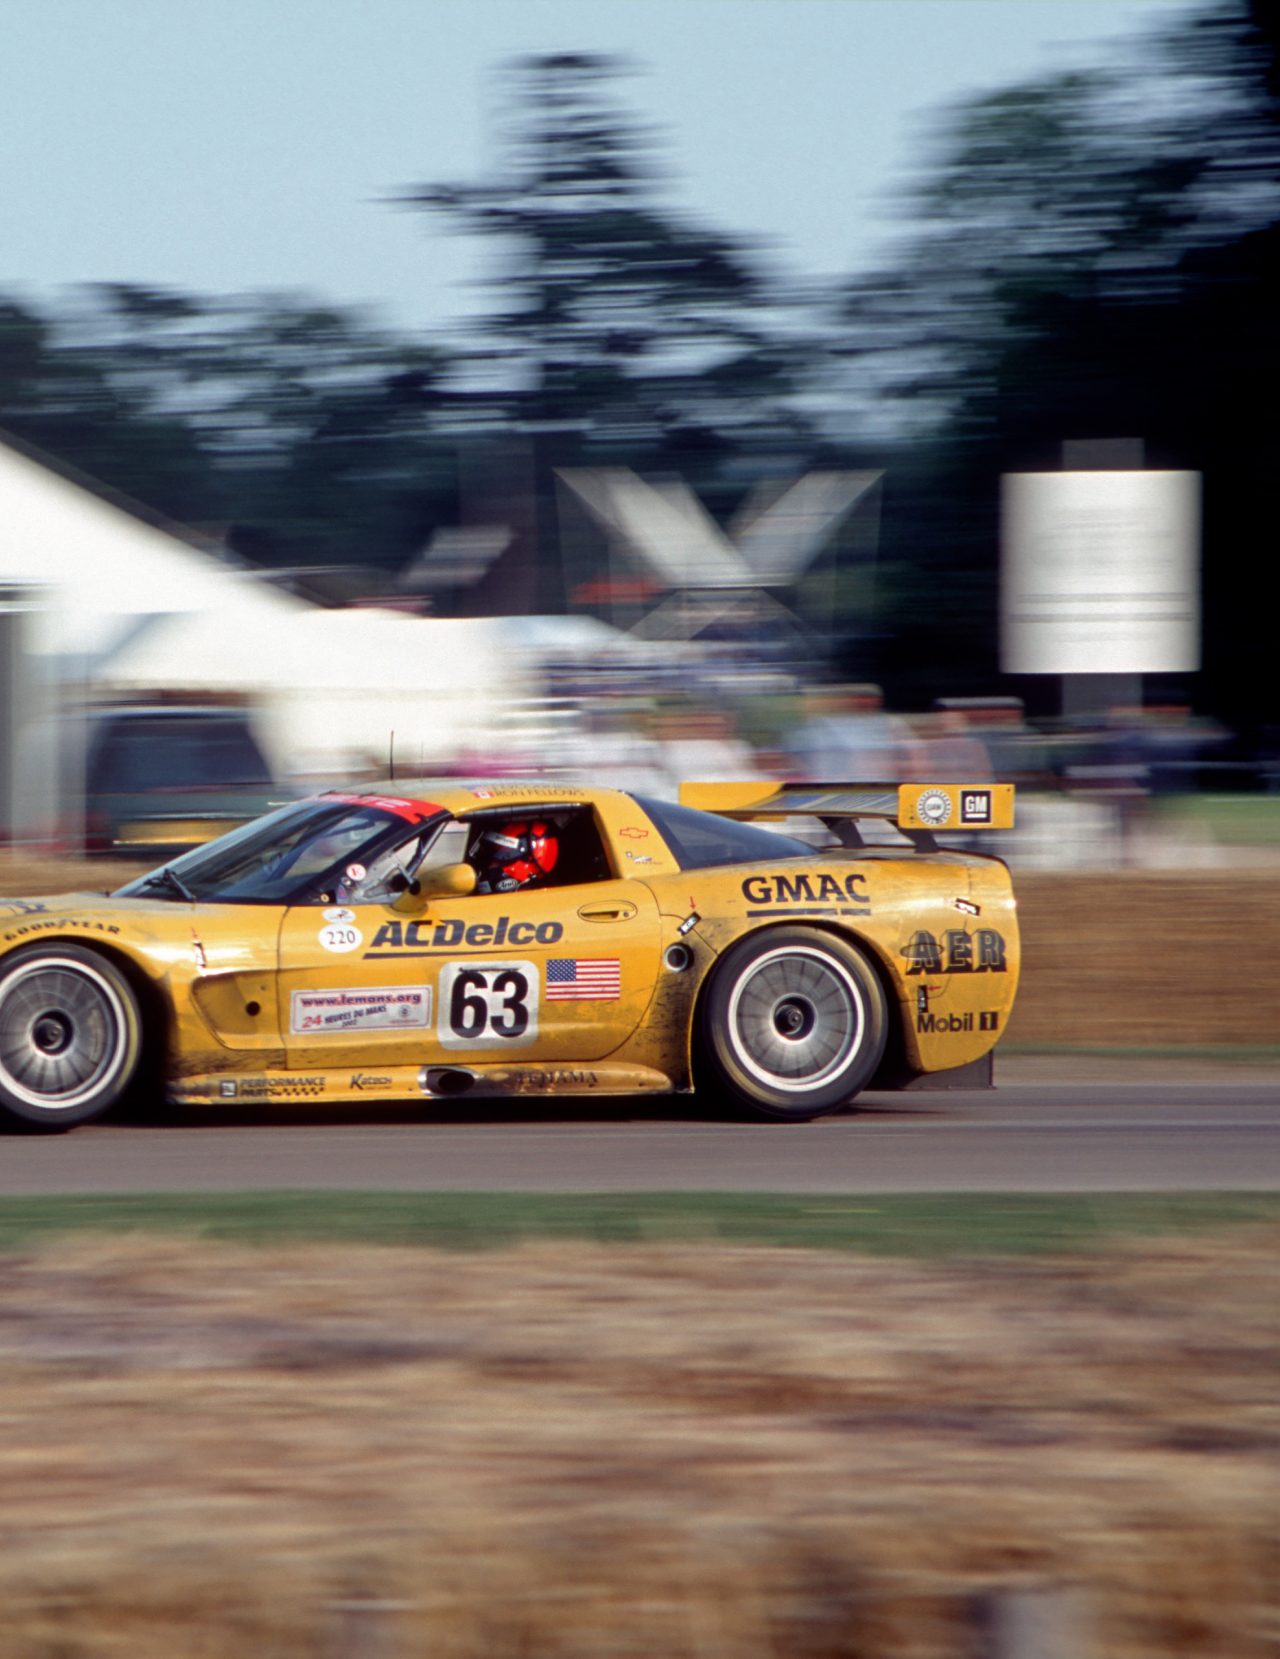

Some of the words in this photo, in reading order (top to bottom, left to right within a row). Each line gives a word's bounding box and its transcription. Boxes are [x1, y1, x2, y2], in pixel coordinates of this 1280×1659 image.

[965, 796, 987, 812] GM
[741, 874, 870, 904] GMAC
[326, 929, 356, 945] 220
[370, 917, 563, 947] ACDelco
[900, 928, 1007, 975] AER
[302, 993, 421, 1007] www.lemans.org
[449, 971, 529, 1039] 63
[302, 1014, 321, 1029] 24
[917, 1012, 973, 1033] Mobil
[982, 1012, 996, 1030] 1
[240, 1077, 326, 1088] PERFORMANCE
